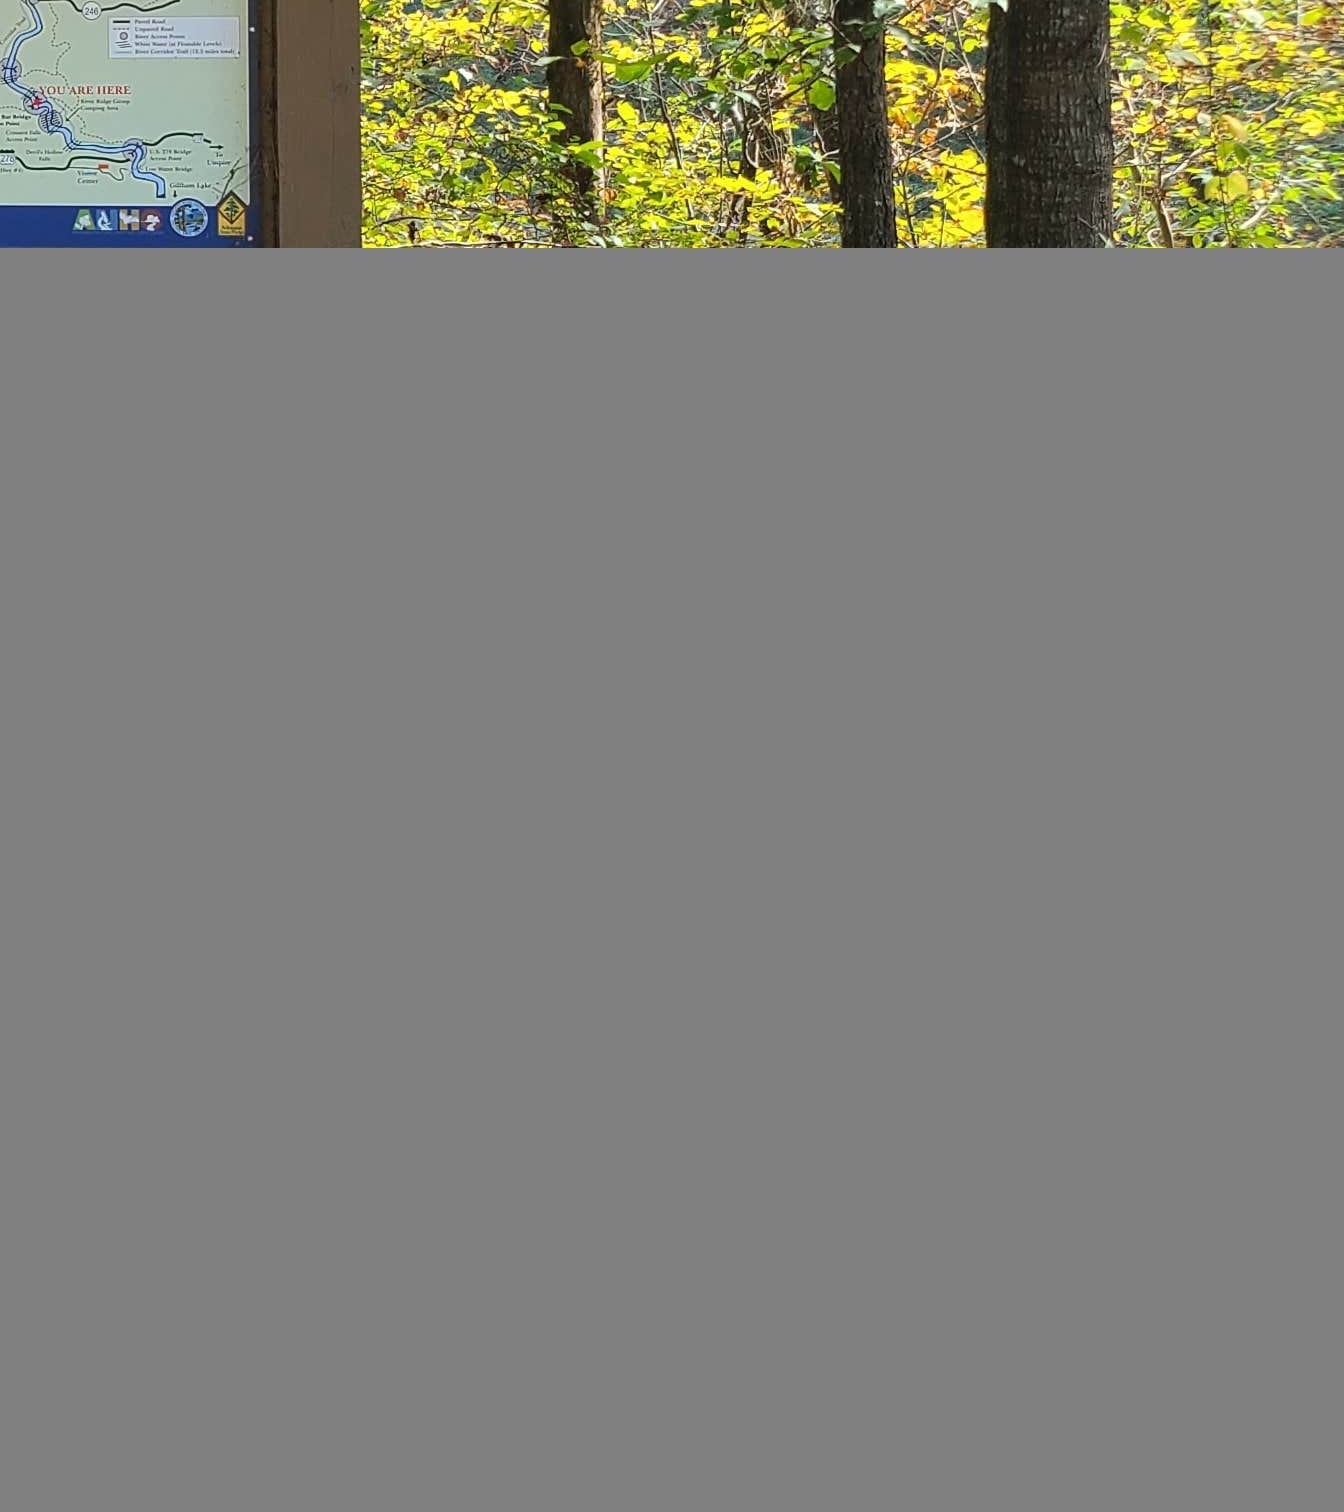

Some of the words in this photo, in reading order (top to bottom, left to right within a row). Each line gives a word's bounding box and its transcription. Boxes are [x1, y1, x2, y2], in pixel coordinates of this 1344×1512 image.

[85, 6, 98, 16] 246
[38, 86, 66, 95] YOU
[69, 86, 94, 95] ARE
[97, 86, 131, 94] HERE
